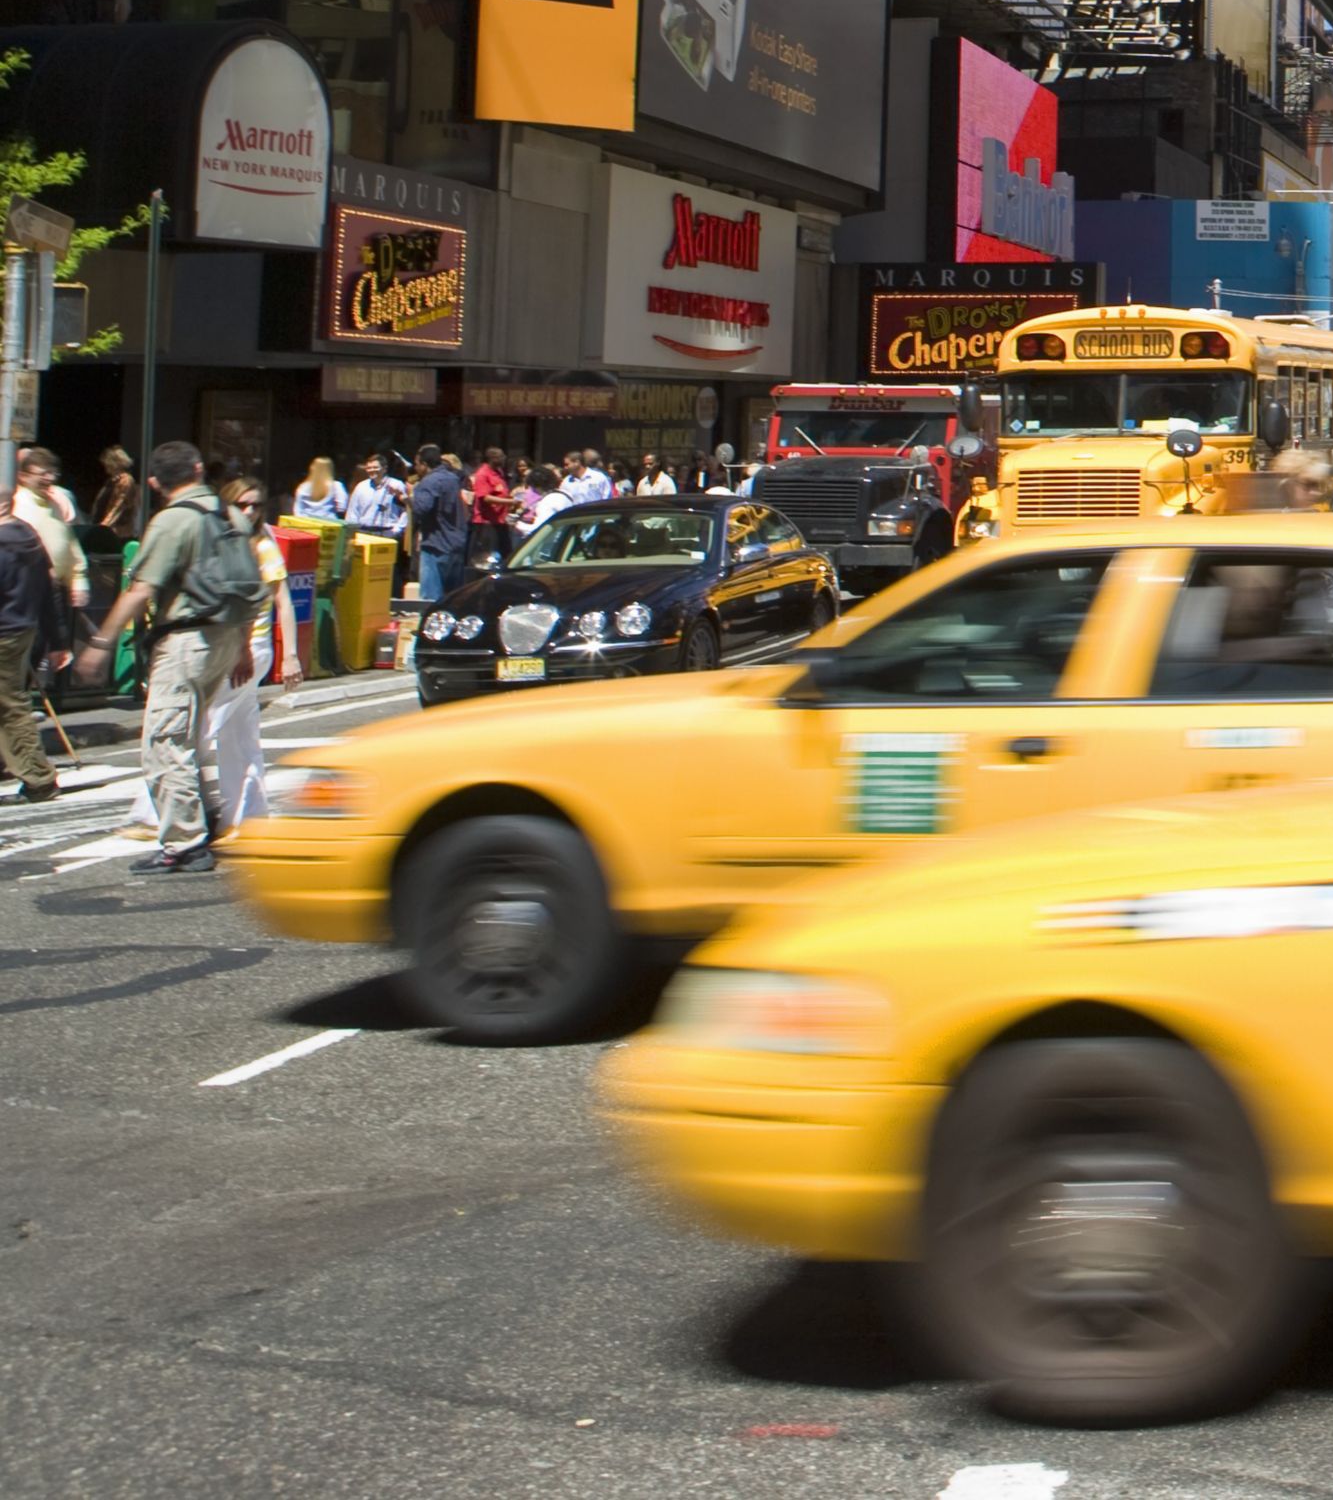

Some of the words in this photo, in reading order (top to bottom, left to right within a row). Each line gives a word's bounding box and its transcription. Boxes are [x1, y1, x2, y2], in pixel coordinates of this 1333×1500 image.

[750, 19, 777, 58] Kodak
[217, 118, 314, 157] Marriott
[202, 156, 231, 172] NEW
[235, 160, 266, 177] YORK
[270, 165, 323, 185] MARQUIS
[332, 165, 463, 216] MARQUIS
[662, 193, 762, 272] Marriott
[875, 267, 1085, 287] MARQUIS
[927, 299, 1028, 340] DROWSY
[1077, 332, 1139, 358] SCHOOL
[1143, 333, 1173, 358] BUS
[829, 396, 904, 412] Dunbar
